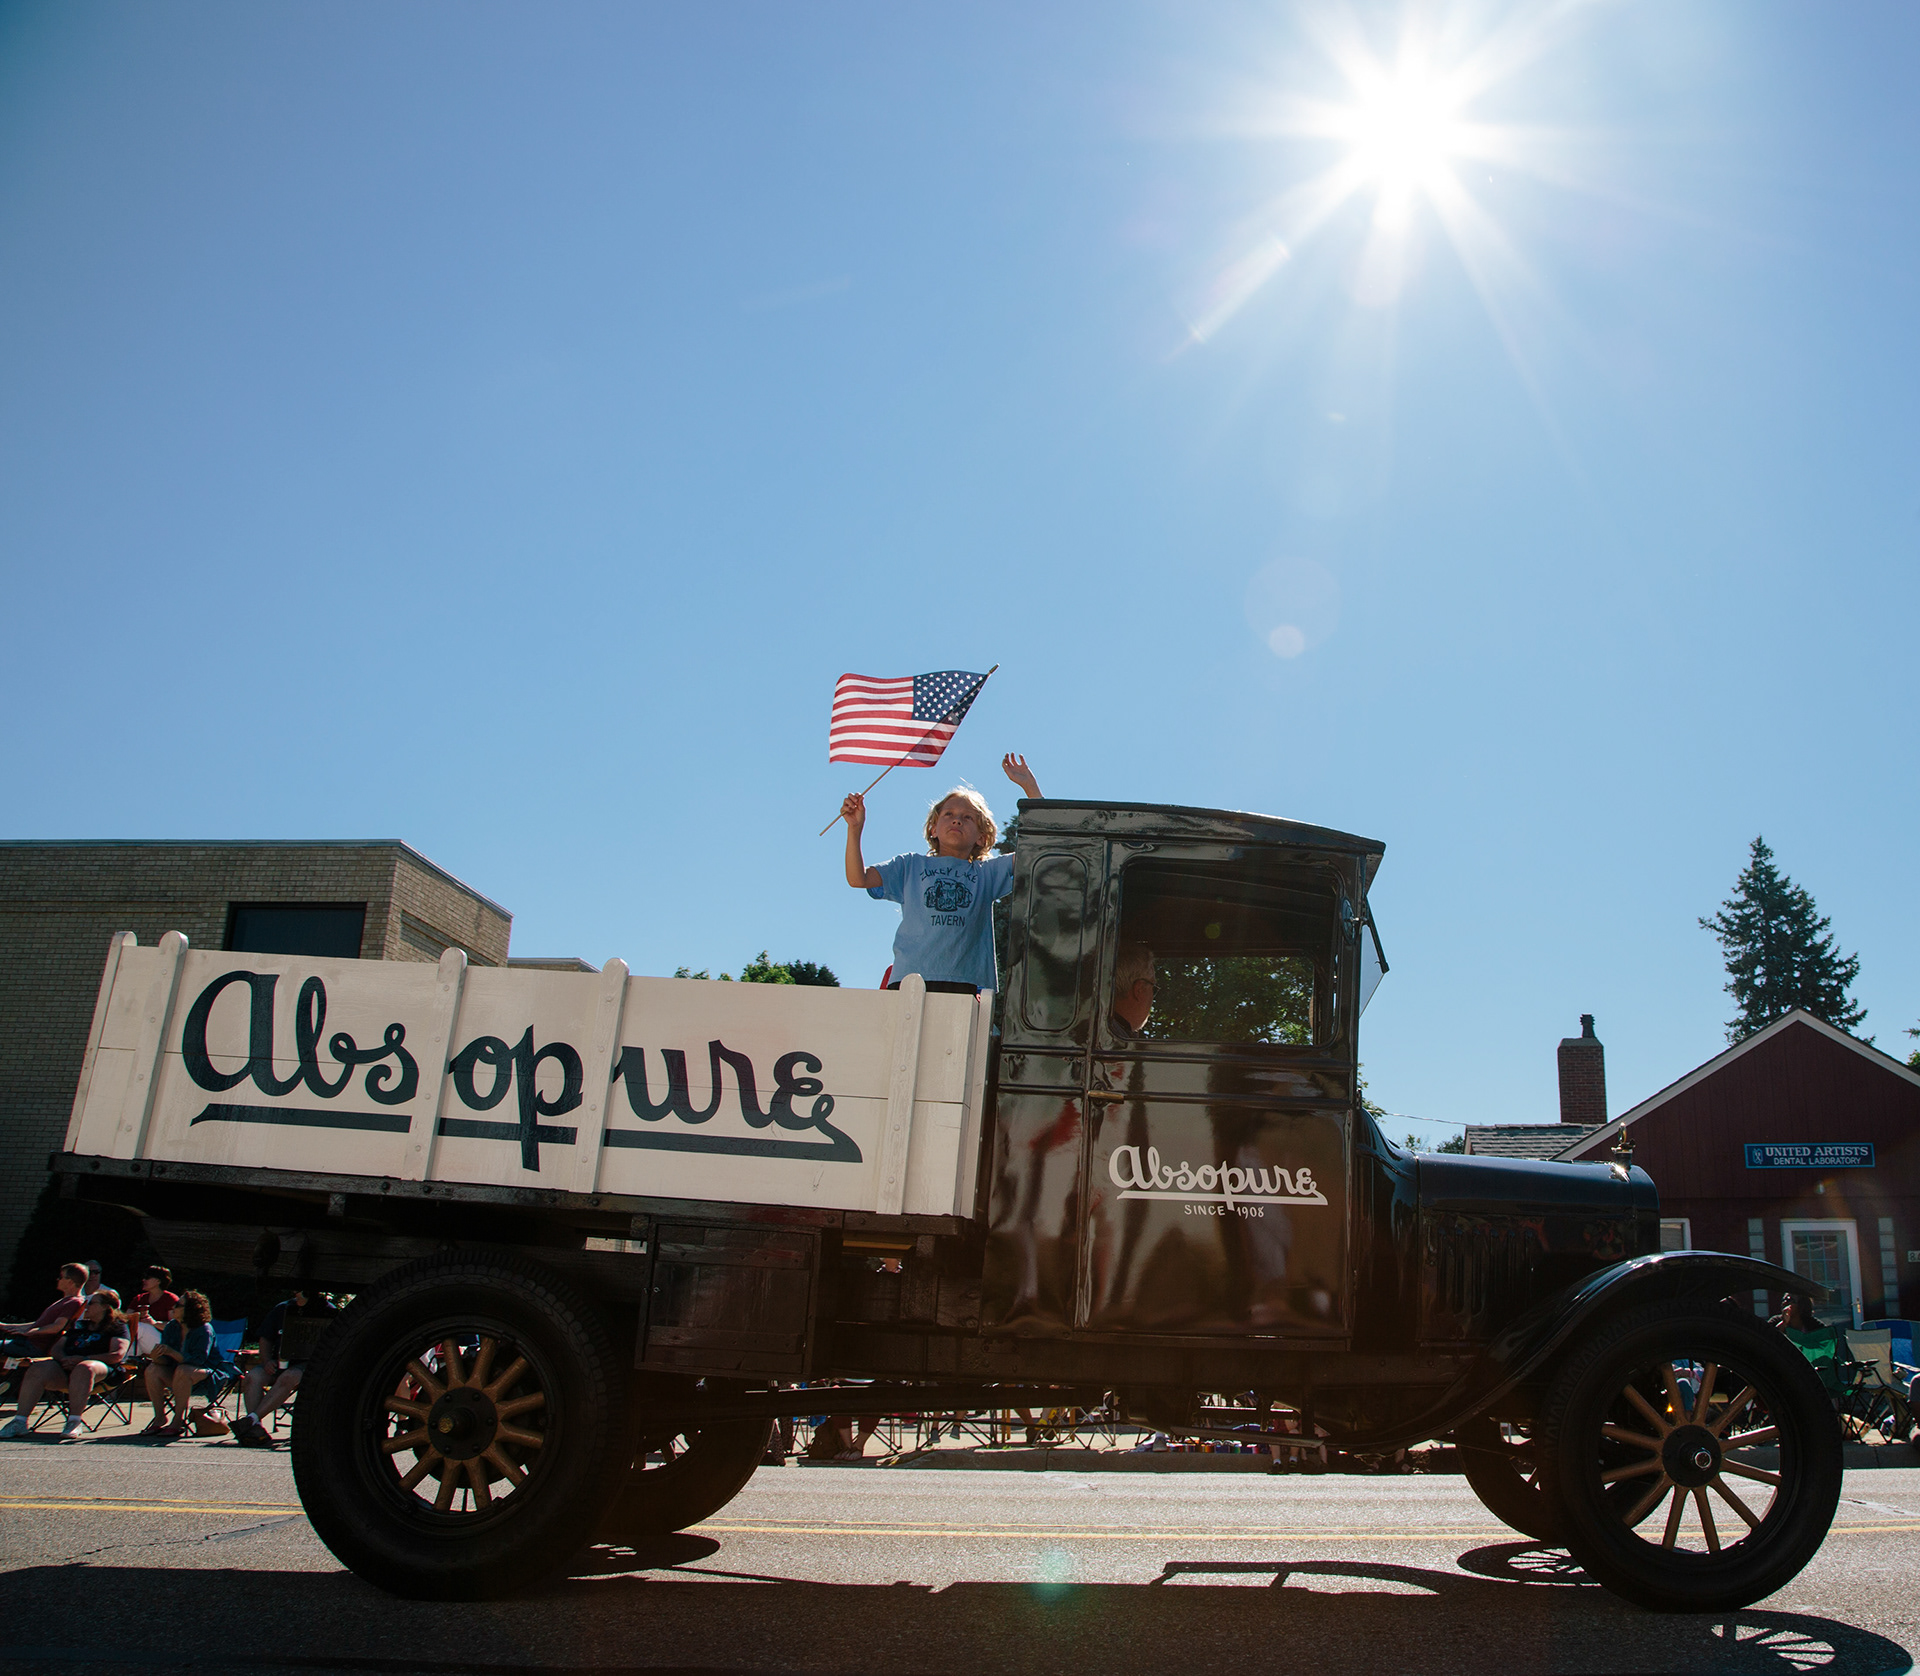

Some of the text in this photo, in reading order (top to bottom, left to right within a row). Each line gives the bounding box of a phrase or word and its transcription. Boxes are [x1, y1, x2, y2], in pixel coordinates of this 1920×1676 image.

[931, 915, 966, 927] TAVERN
[1765, 1146, 1869, 1157] UNITED ARTISTS
[1773, 1156, 1861, 1165] DENTAL LABORATORY
[1108, 1145, 1328, 1211] Absopure
[1184, 1204, 1265, 1219] SINCE 1908
